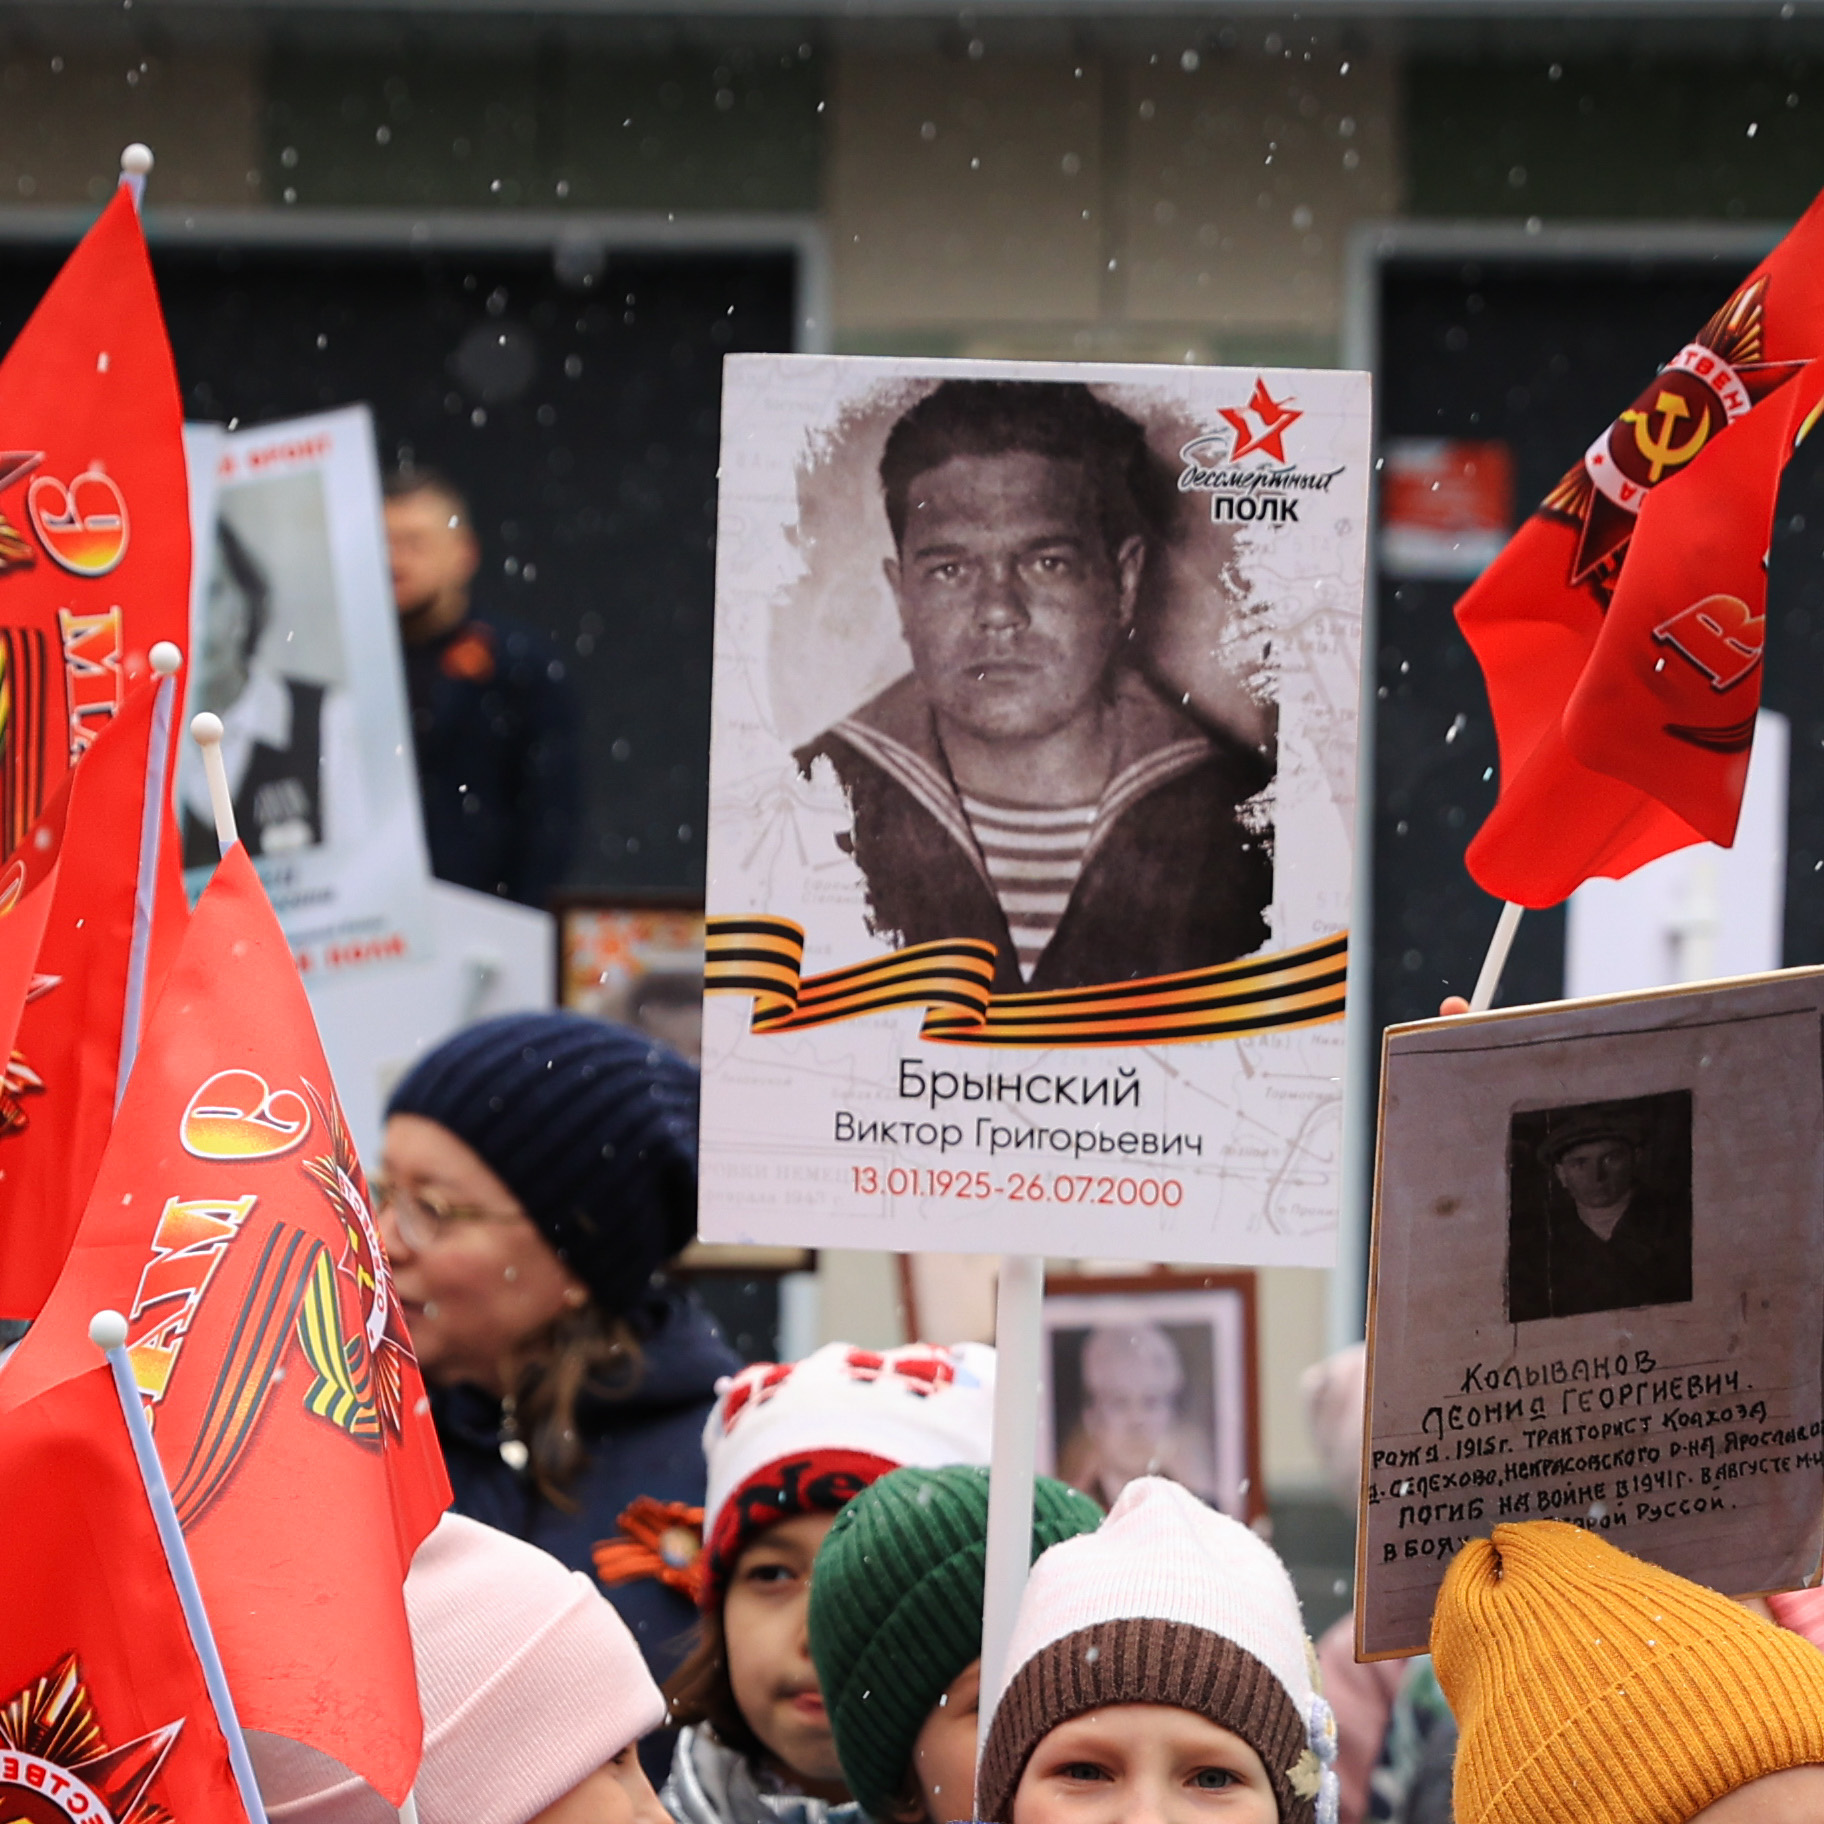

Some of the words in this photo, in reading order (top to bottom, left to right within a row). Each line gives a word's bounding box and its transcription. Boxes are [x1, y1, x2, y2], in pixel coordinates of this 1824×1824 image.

[1179, 434, 1346, 493] бессмертный
[1215, 496, 1299, 523] ПОЛК
[898, 1057, 1142, 1112] Брынский
[834, 1111, 963, 1154] Виктор
[975, 1120, 1204, 1163] Григорьевич
[850, 1165, 1184, 1210] 13.01.1925-26.07.2000
[1460, 1349, 1657, 1394] КОЛЫВАНОВ
[1399, 1497, 1485, 1529] ПОГИБ
[1543, 1501, 1628, 1531] АРОЙ
